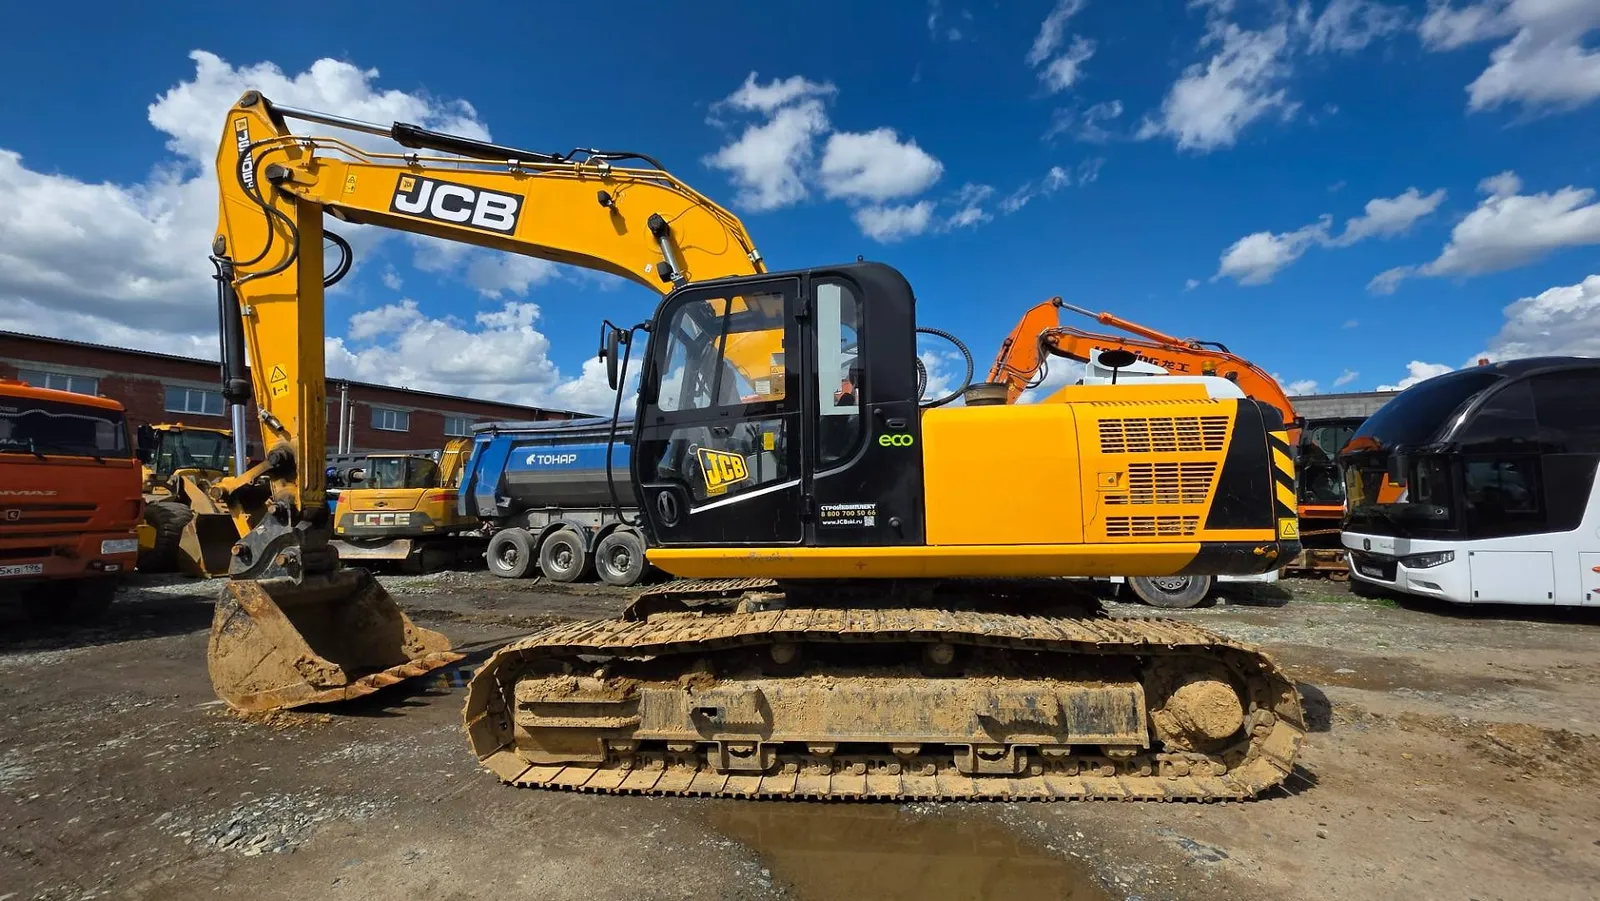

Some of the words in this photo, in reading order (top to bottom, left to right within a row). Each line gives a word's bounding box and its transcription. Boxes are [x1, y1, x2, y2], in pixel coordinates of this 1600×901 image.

[395, 180, 518, 230] JCB
[879, 434, 914, 446] eco
[537, 454, 577, 465] ТОНАР
[706, 452, 745, 485] JCB
